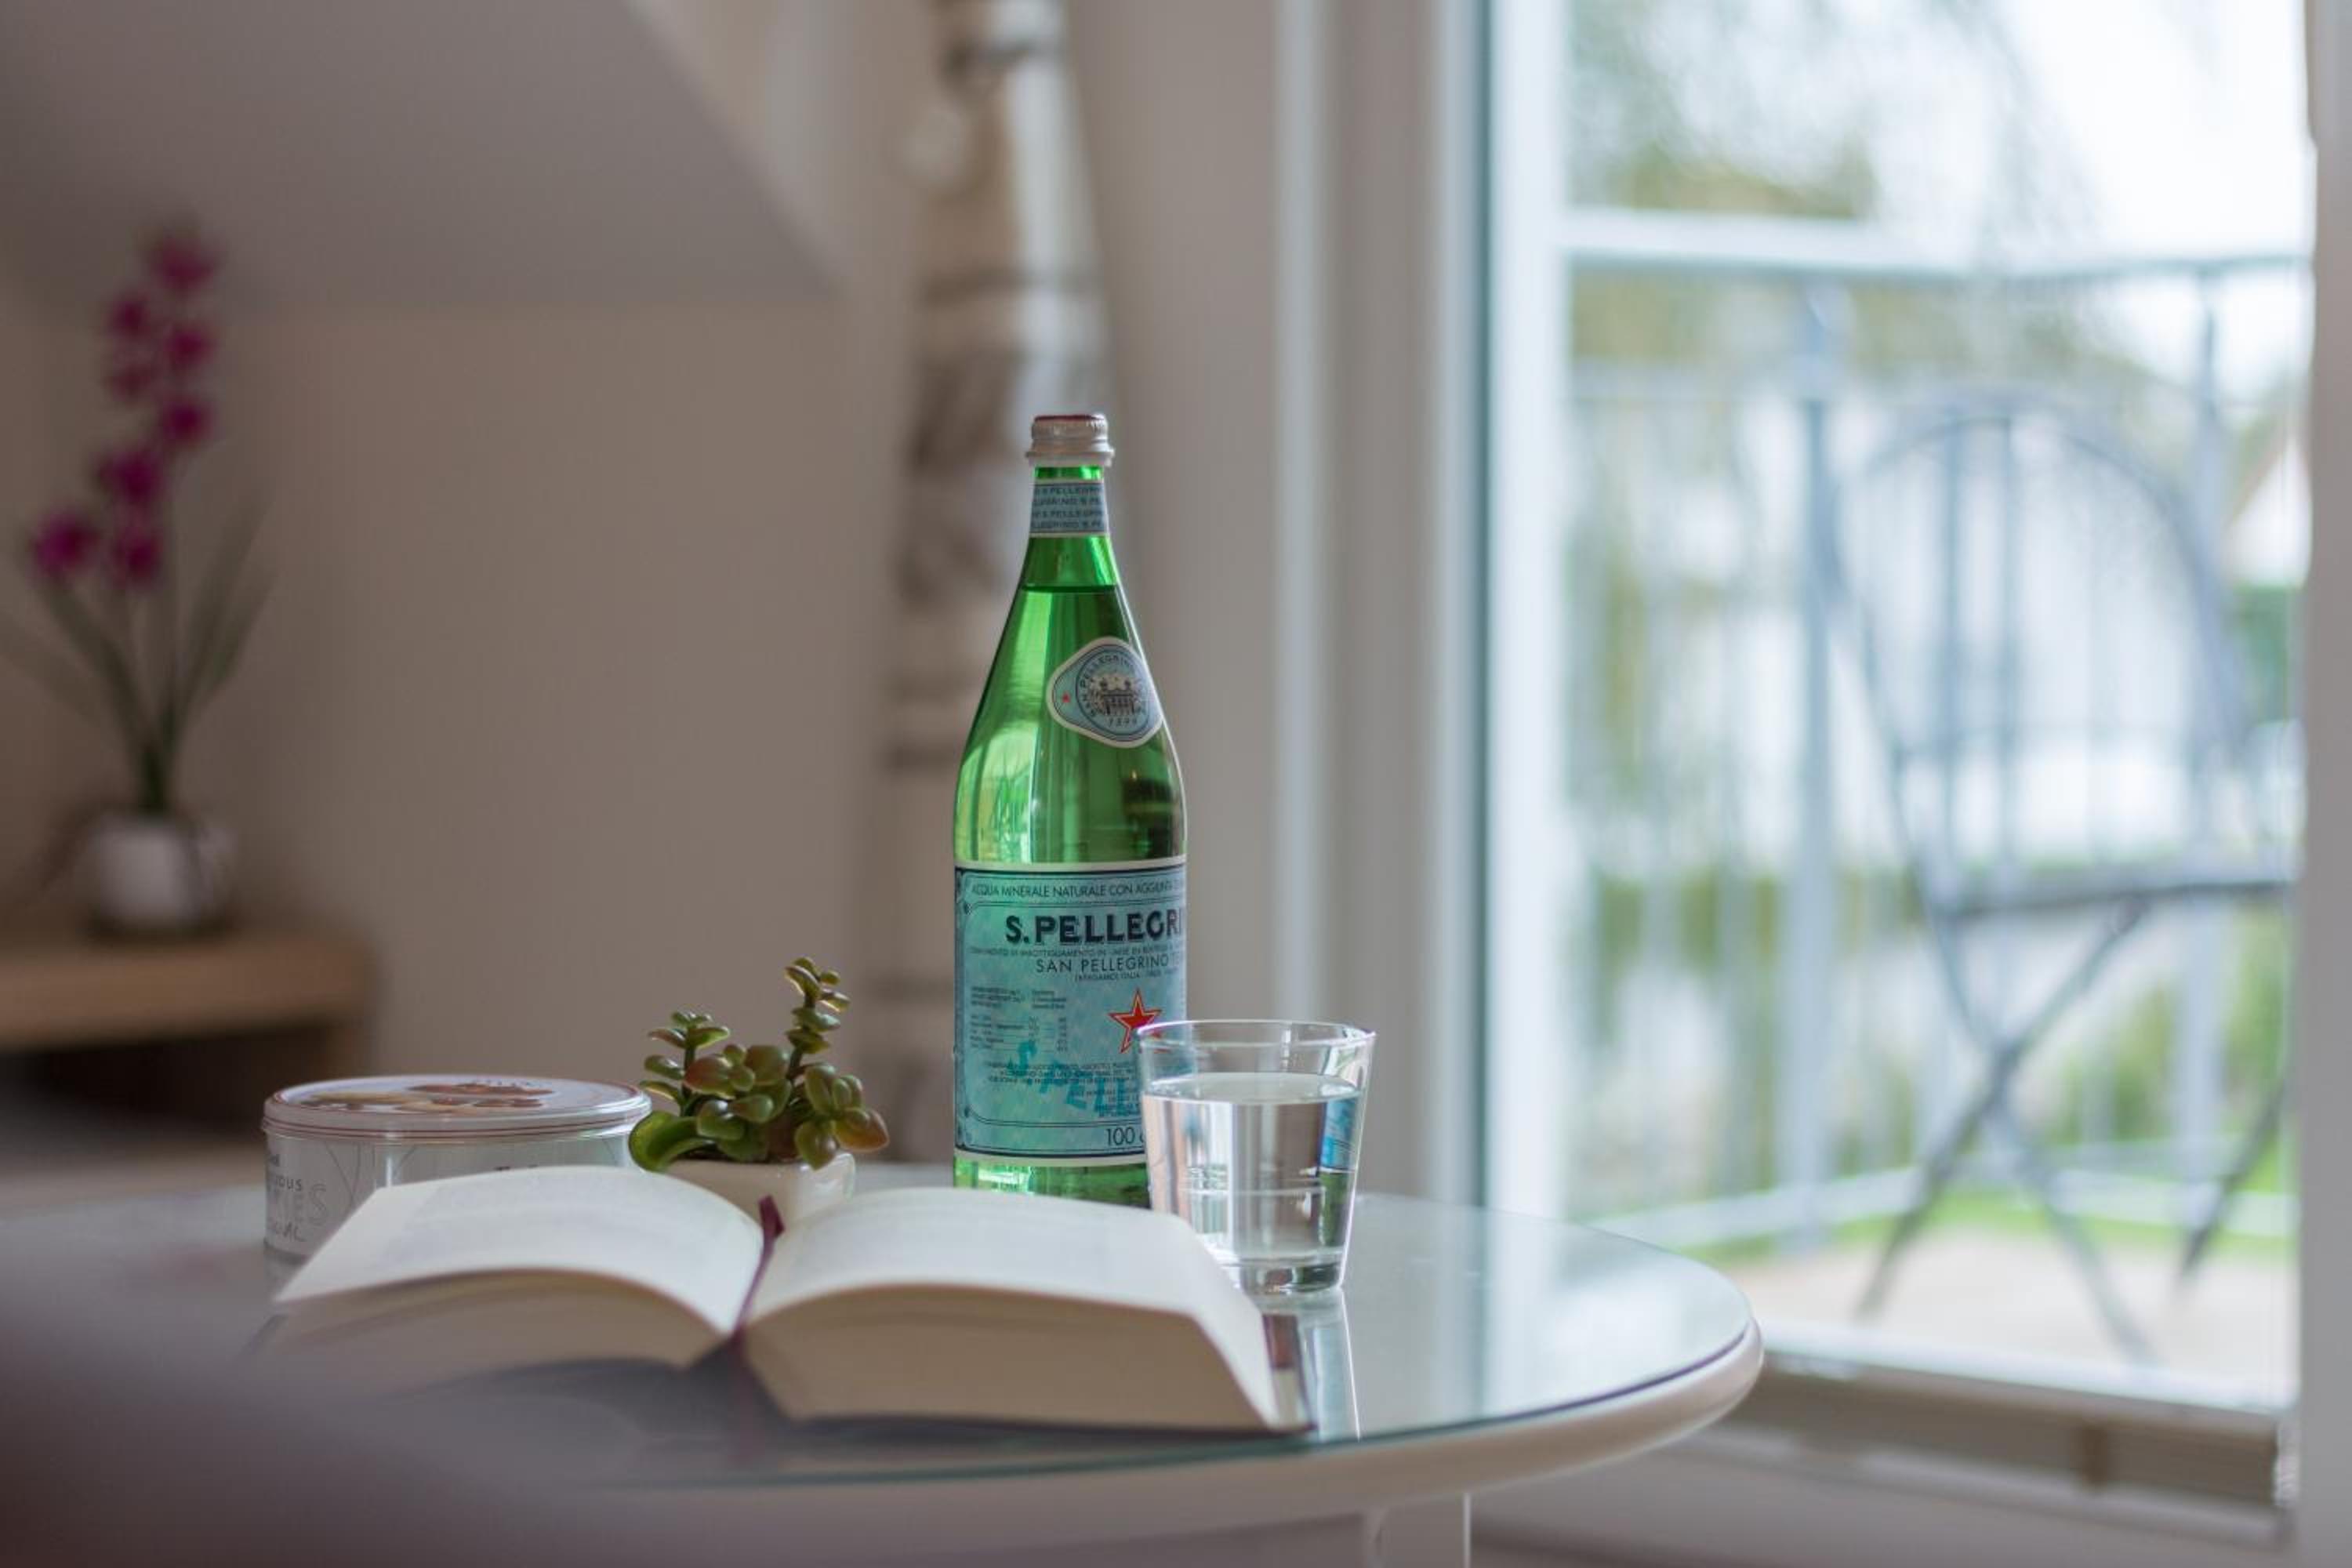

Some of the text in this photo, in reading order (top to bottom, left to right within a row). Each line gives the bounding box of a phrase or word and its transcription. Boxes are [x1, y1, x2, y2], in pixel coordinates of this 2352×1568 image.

[1002, 885, 1050, 898] MINERALE
[1052, 884, 1106, 898] NATURALE
[1109, 884, 1133, 895] CON
[1036, 959, 1073, 973] SAN
[1080, 953, 1170, 972] PELLEGRINO
[1105, 1127, 1136, 1146] 100
